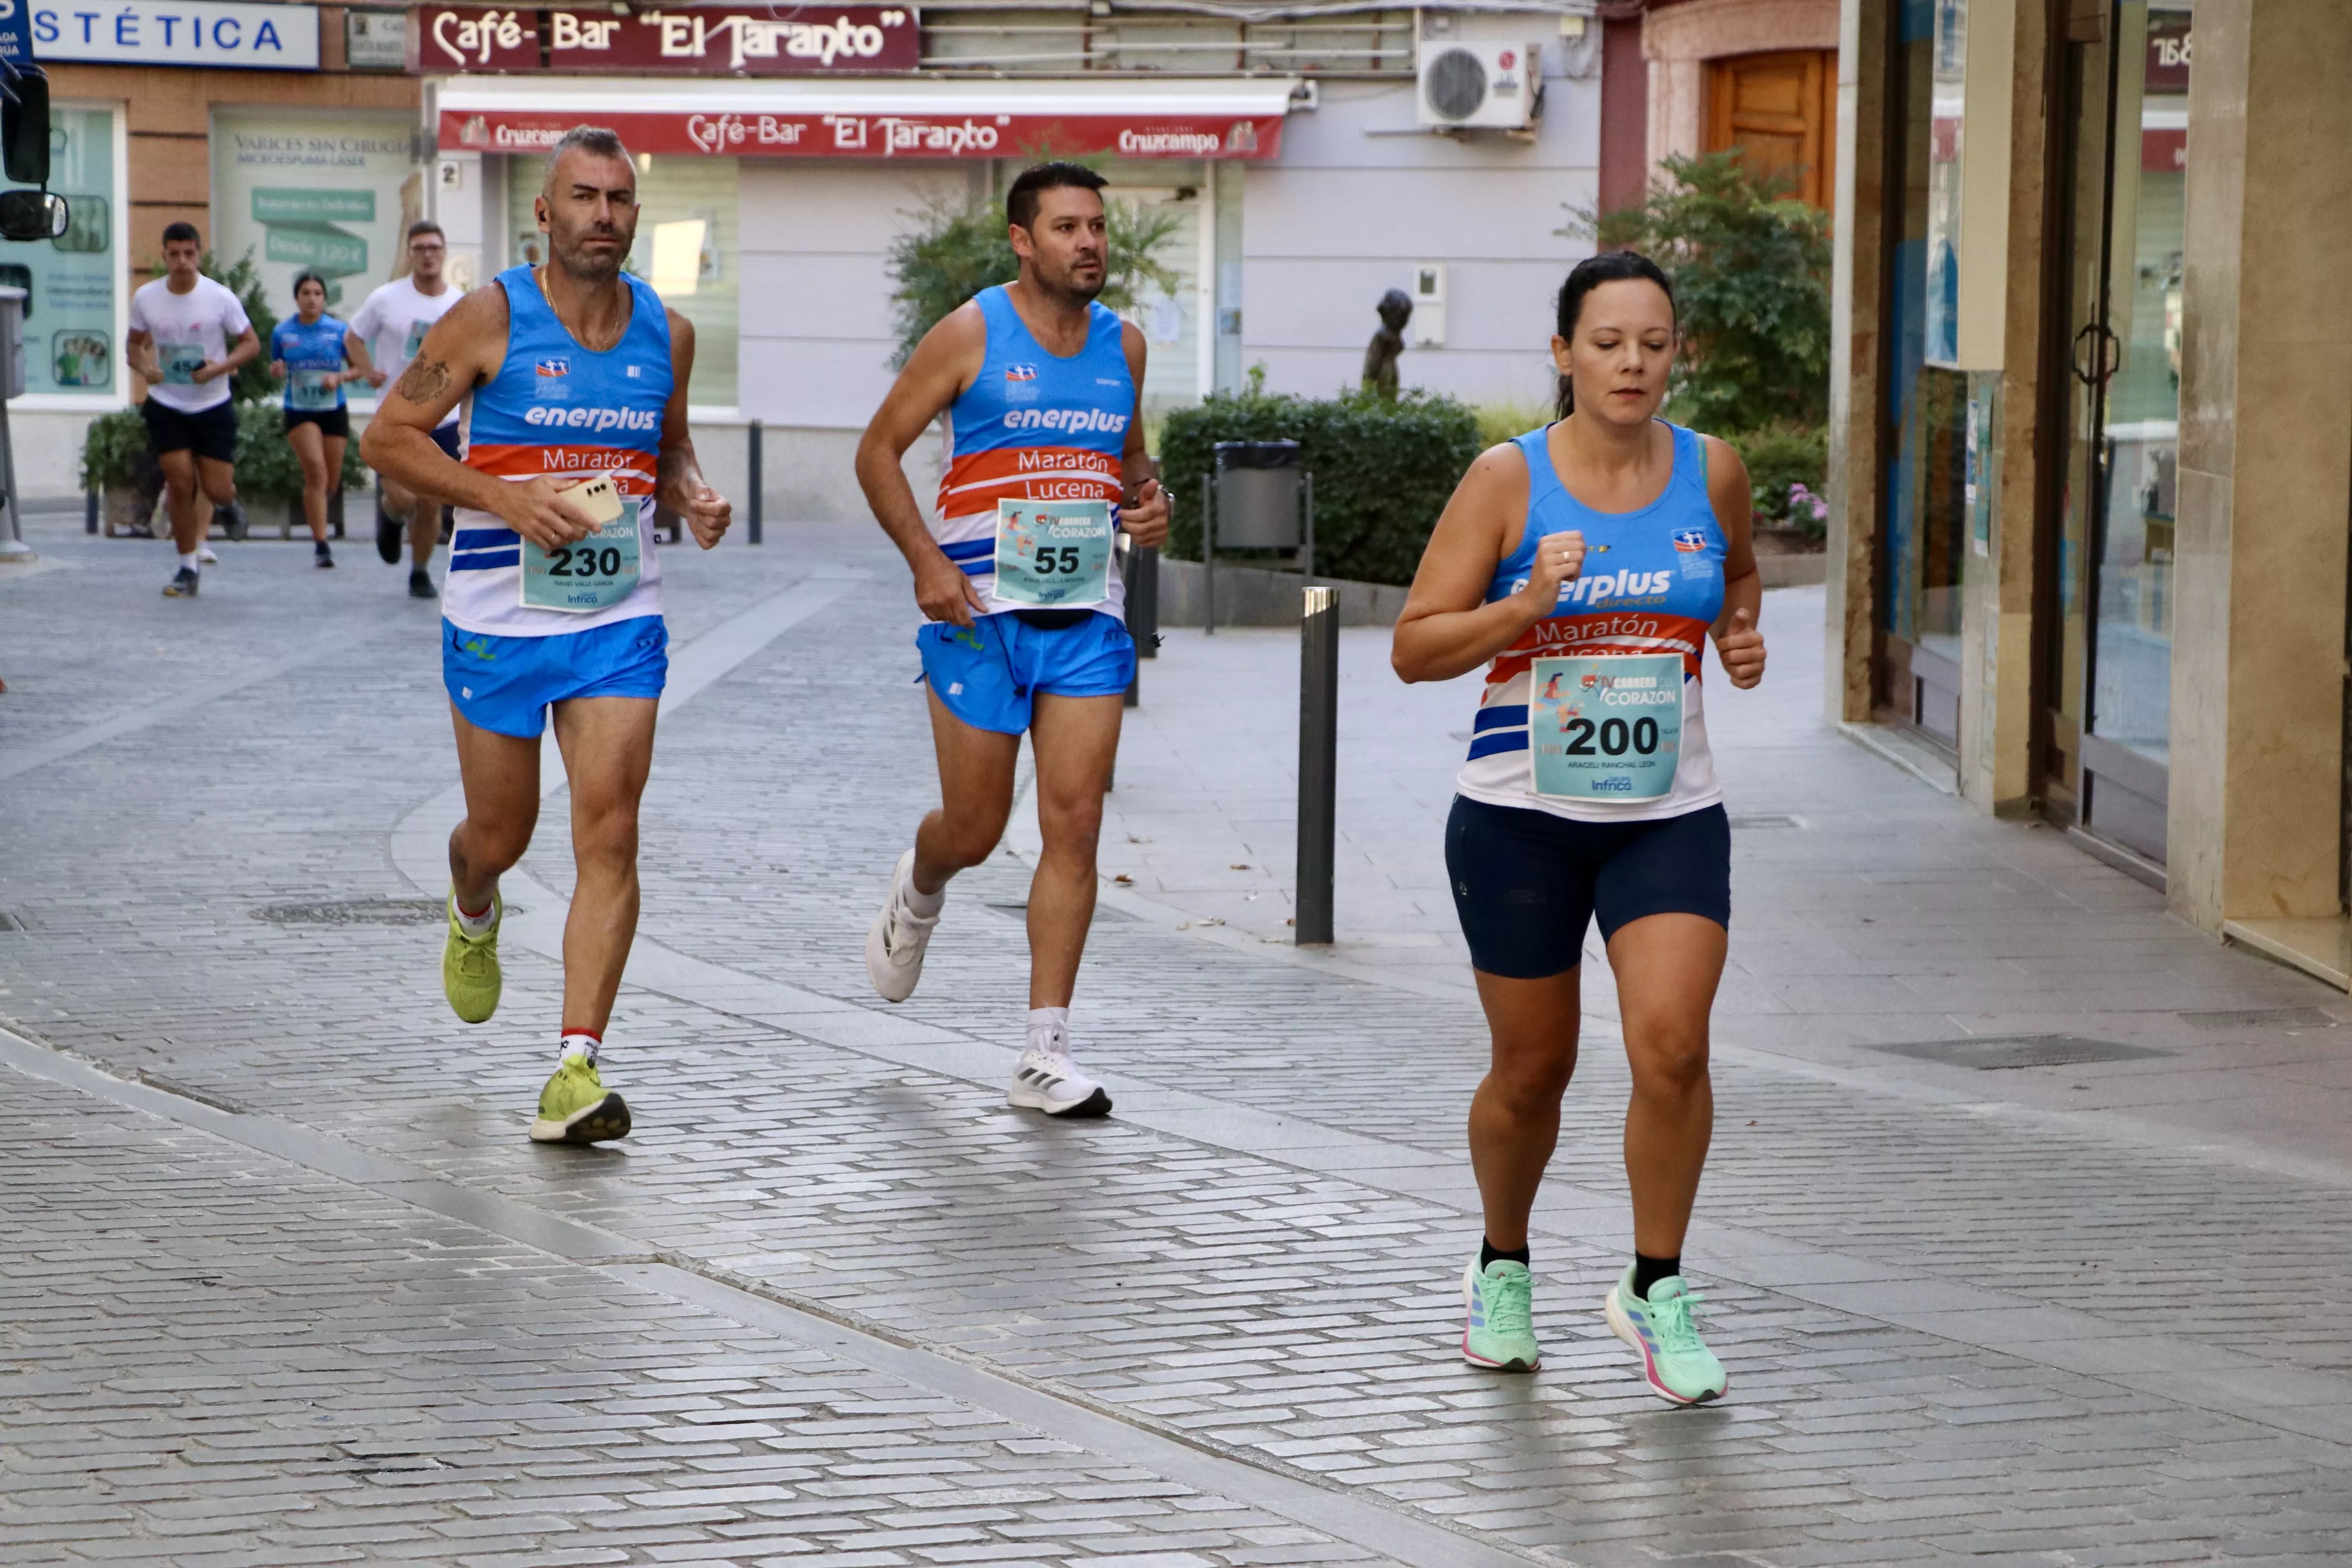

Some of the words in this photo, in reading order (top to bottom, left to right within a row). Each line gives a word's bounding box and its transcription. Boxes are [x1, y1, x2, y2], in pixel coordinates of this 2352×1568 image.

[551, 12, 621, 50] Bar
[687, 114, 808, 154] Café-Bar
[1119, 128, 1220, 155] Cruzcampo
[443, 164, 455, 184] 2
[525, 406, 656, 433] enerplus
[1004, 408, 1126, 434] enerplus
[1018, 450, 1108, 473] Maratón
[1025, 481, 1104, 499] Lucena
[548, 547, 620, 576] 230
[1034, 546, 1080, 574] 55
[567, 594, 598, 603] Infrico
[1511, 569, 1671, 606] eerplus
[1595, 596, 1666, 609] directo
[1535, 613, 1658, 644] Maratón
[1566, 716, 1659, 756] 200
[1592, 779, 1632, 791] Infrico
